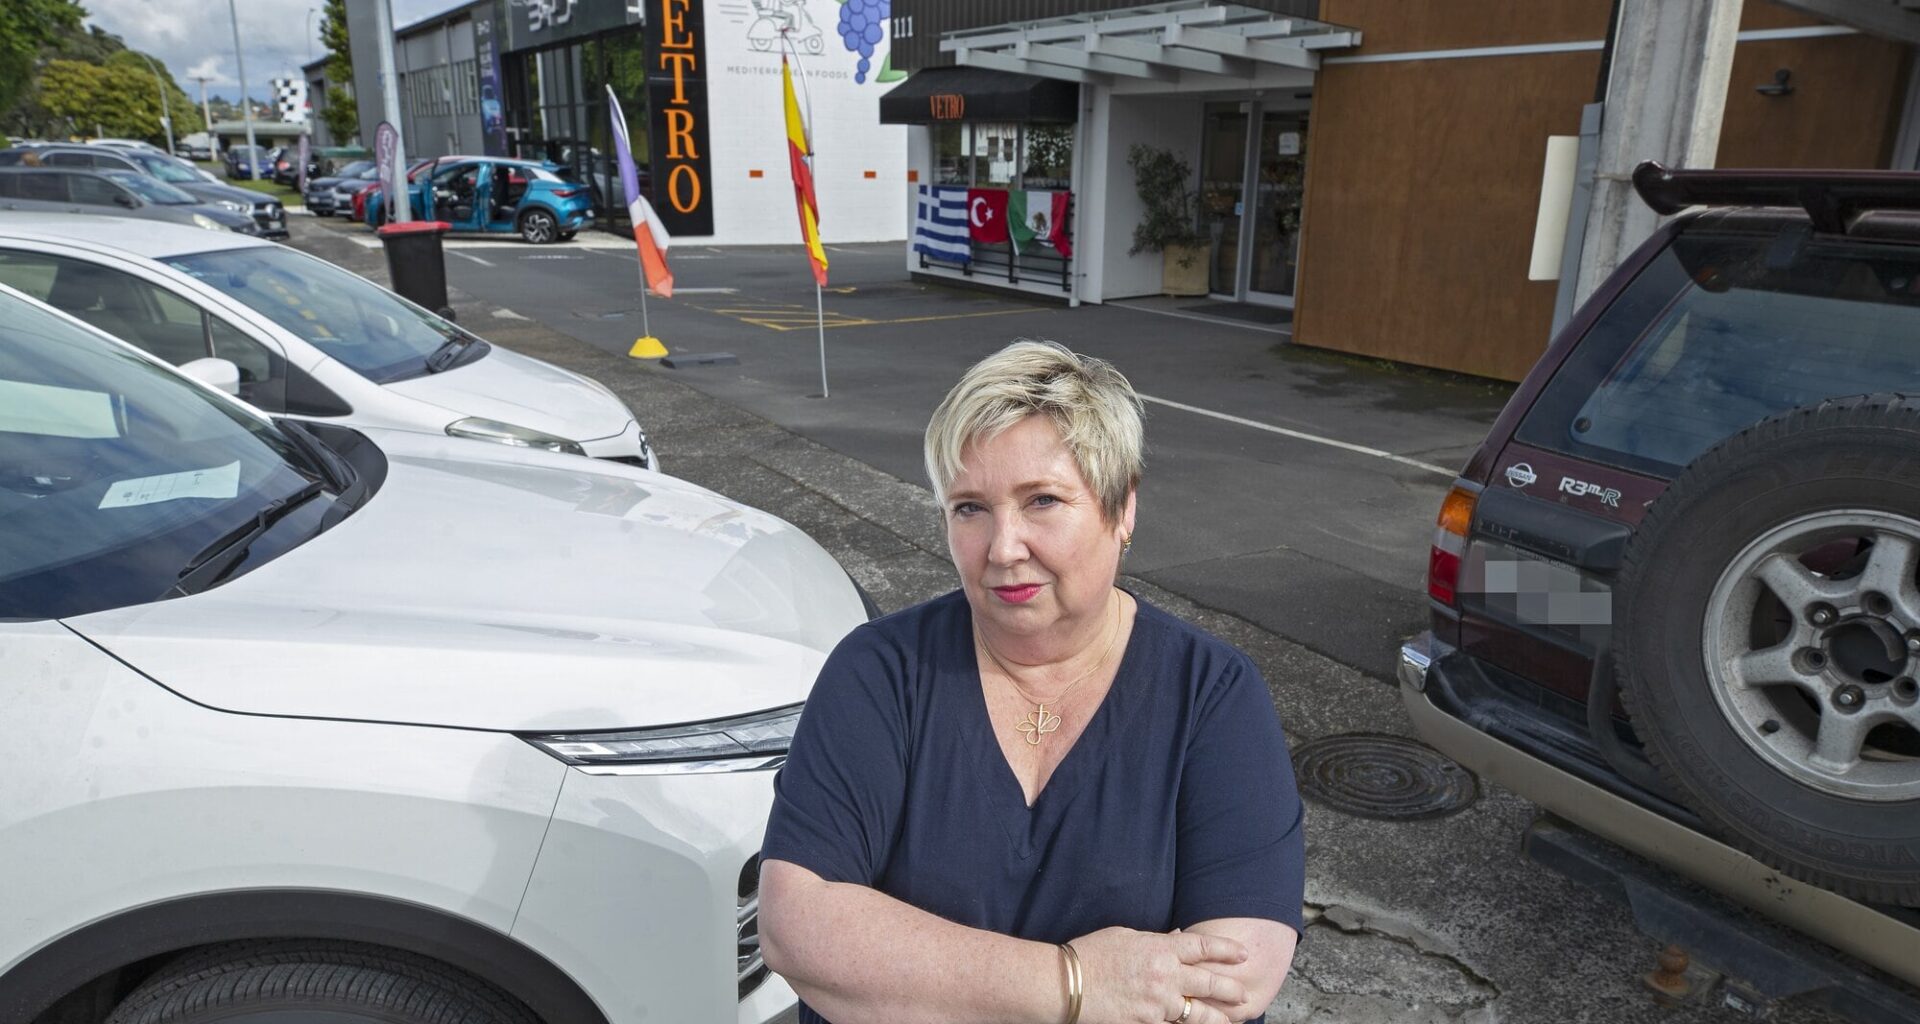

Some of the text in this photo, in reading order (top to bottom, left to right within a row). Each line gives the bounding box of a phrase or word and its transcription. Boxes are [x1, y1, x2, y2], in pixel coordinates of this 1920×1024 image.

[894, 16, 913, 39] 111
[727, 65, 848, 79] MEDITERREN FOODS
[660, 0, 701, 213] ETRO
[929, 94, 965, 119] VETRO
